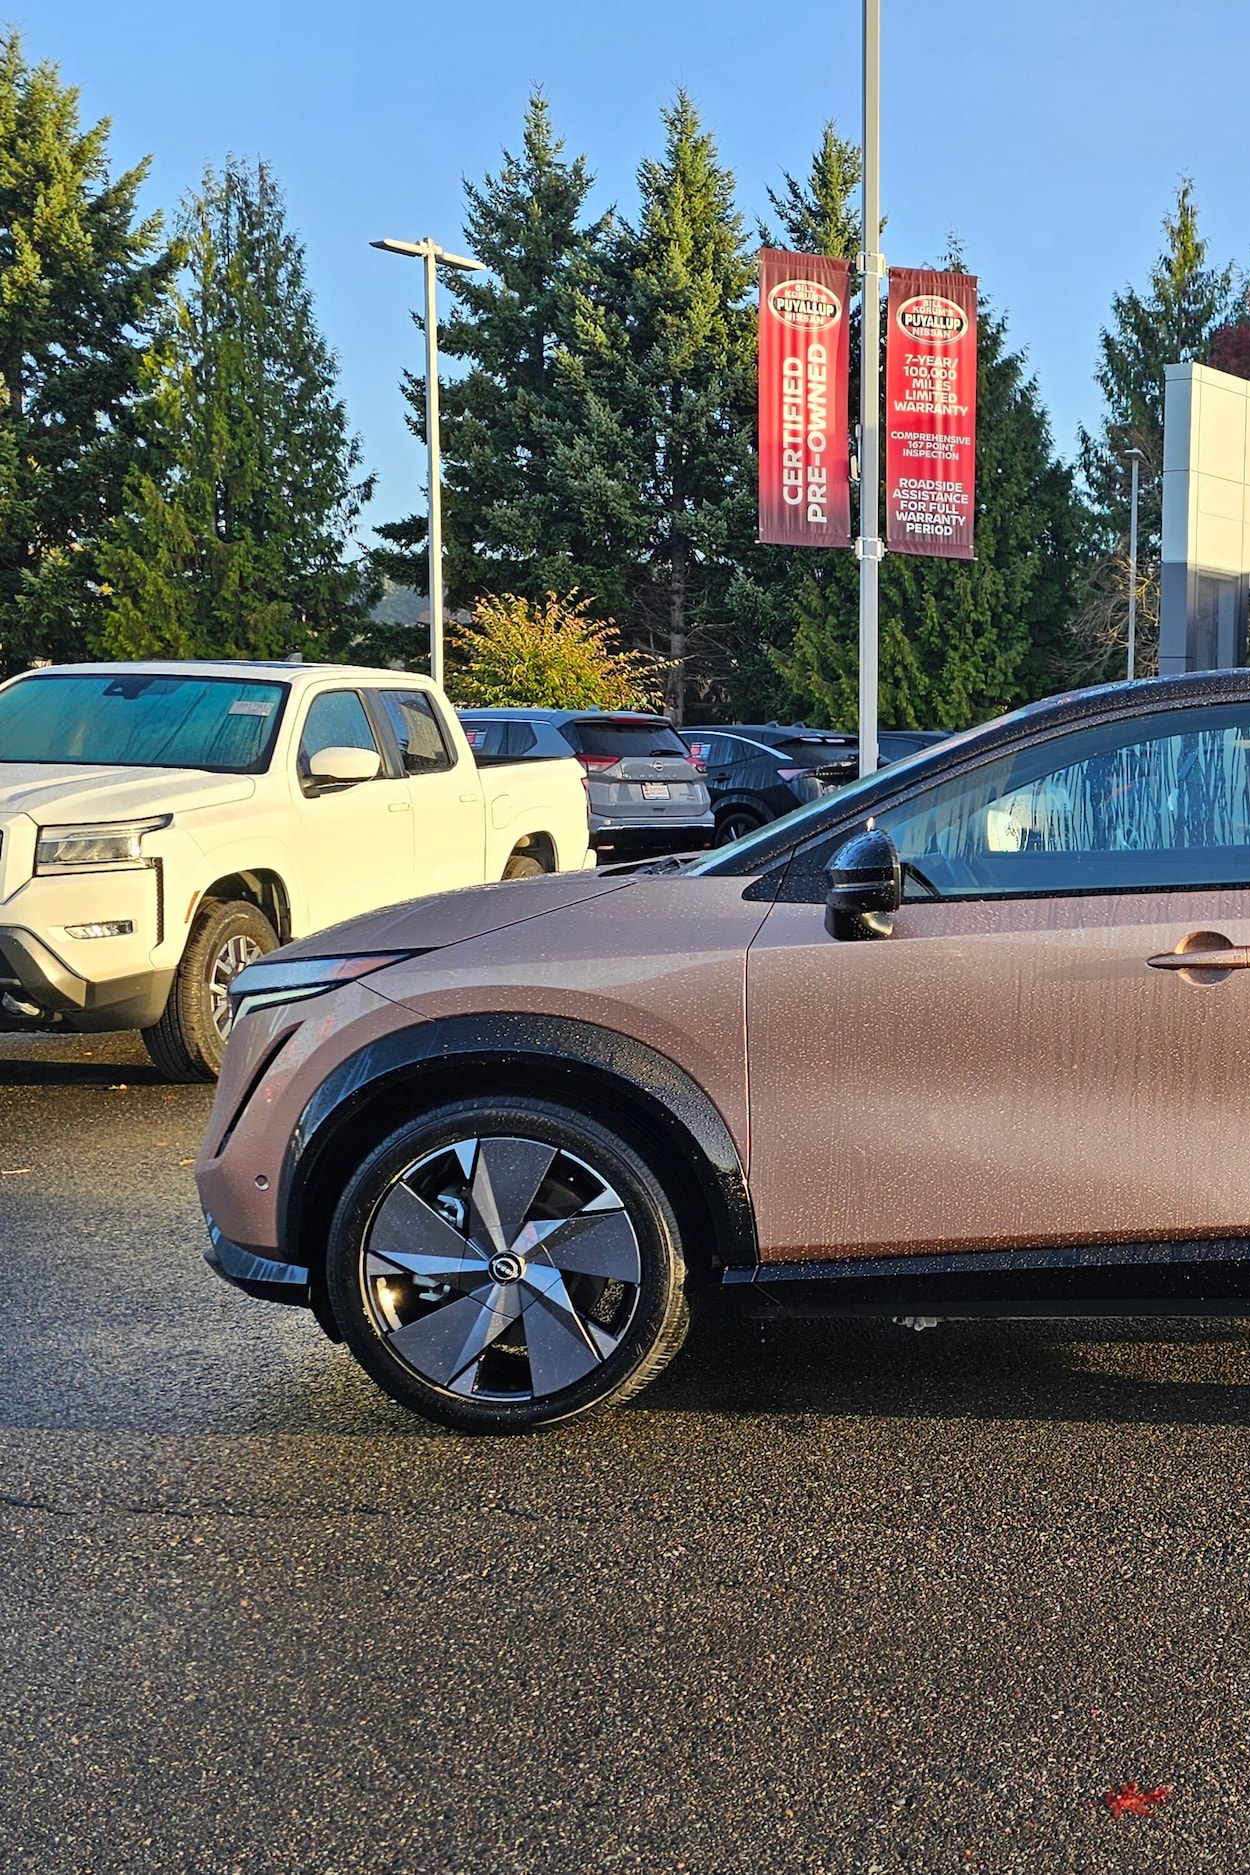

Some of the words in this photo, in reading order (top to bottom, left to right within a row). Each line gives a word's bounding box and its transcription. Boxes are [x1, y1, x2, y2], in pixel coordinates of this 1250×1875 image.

[795, 284, 815, 292] BILL
[776, 297, 834, 317] PUYALLUP
[923, 300, 942, 308] BILL
[784, 311, 824, 324] NISSAN
[904, 313, 961, 331] PUYALLUP
[912, 327, 951, 339] NISSAN
[904, 353, 959, 369] 7-YEAR/
[903, 365, 957, 381] 100,000
[912, 378, 951, 392] MILES
[905, 389, 958, 404] LIMITED
[894, 400, 968, 417] WARRANTY
[782, 356, 804, 506] CERTIFIED
[807, 343, 828, 524] PRE-OWNED
[890, 431, 971, 445] COMPREHENSIVE
[907, 441, 924, 449] 167
[925, 441, 955, 452] POINT
[902, 448, 959, 460] INSPECTION
[899, 478, 963, 492] ROADSIDE
[892, 488, 969, 504] ASSISTANCE
[900, 500, 926, 511] FOR
[929, 502, 959, 514] FULL
[895, 510, 966, 526] WARRANTY
[906, 522, 953, 536] PERIOD
